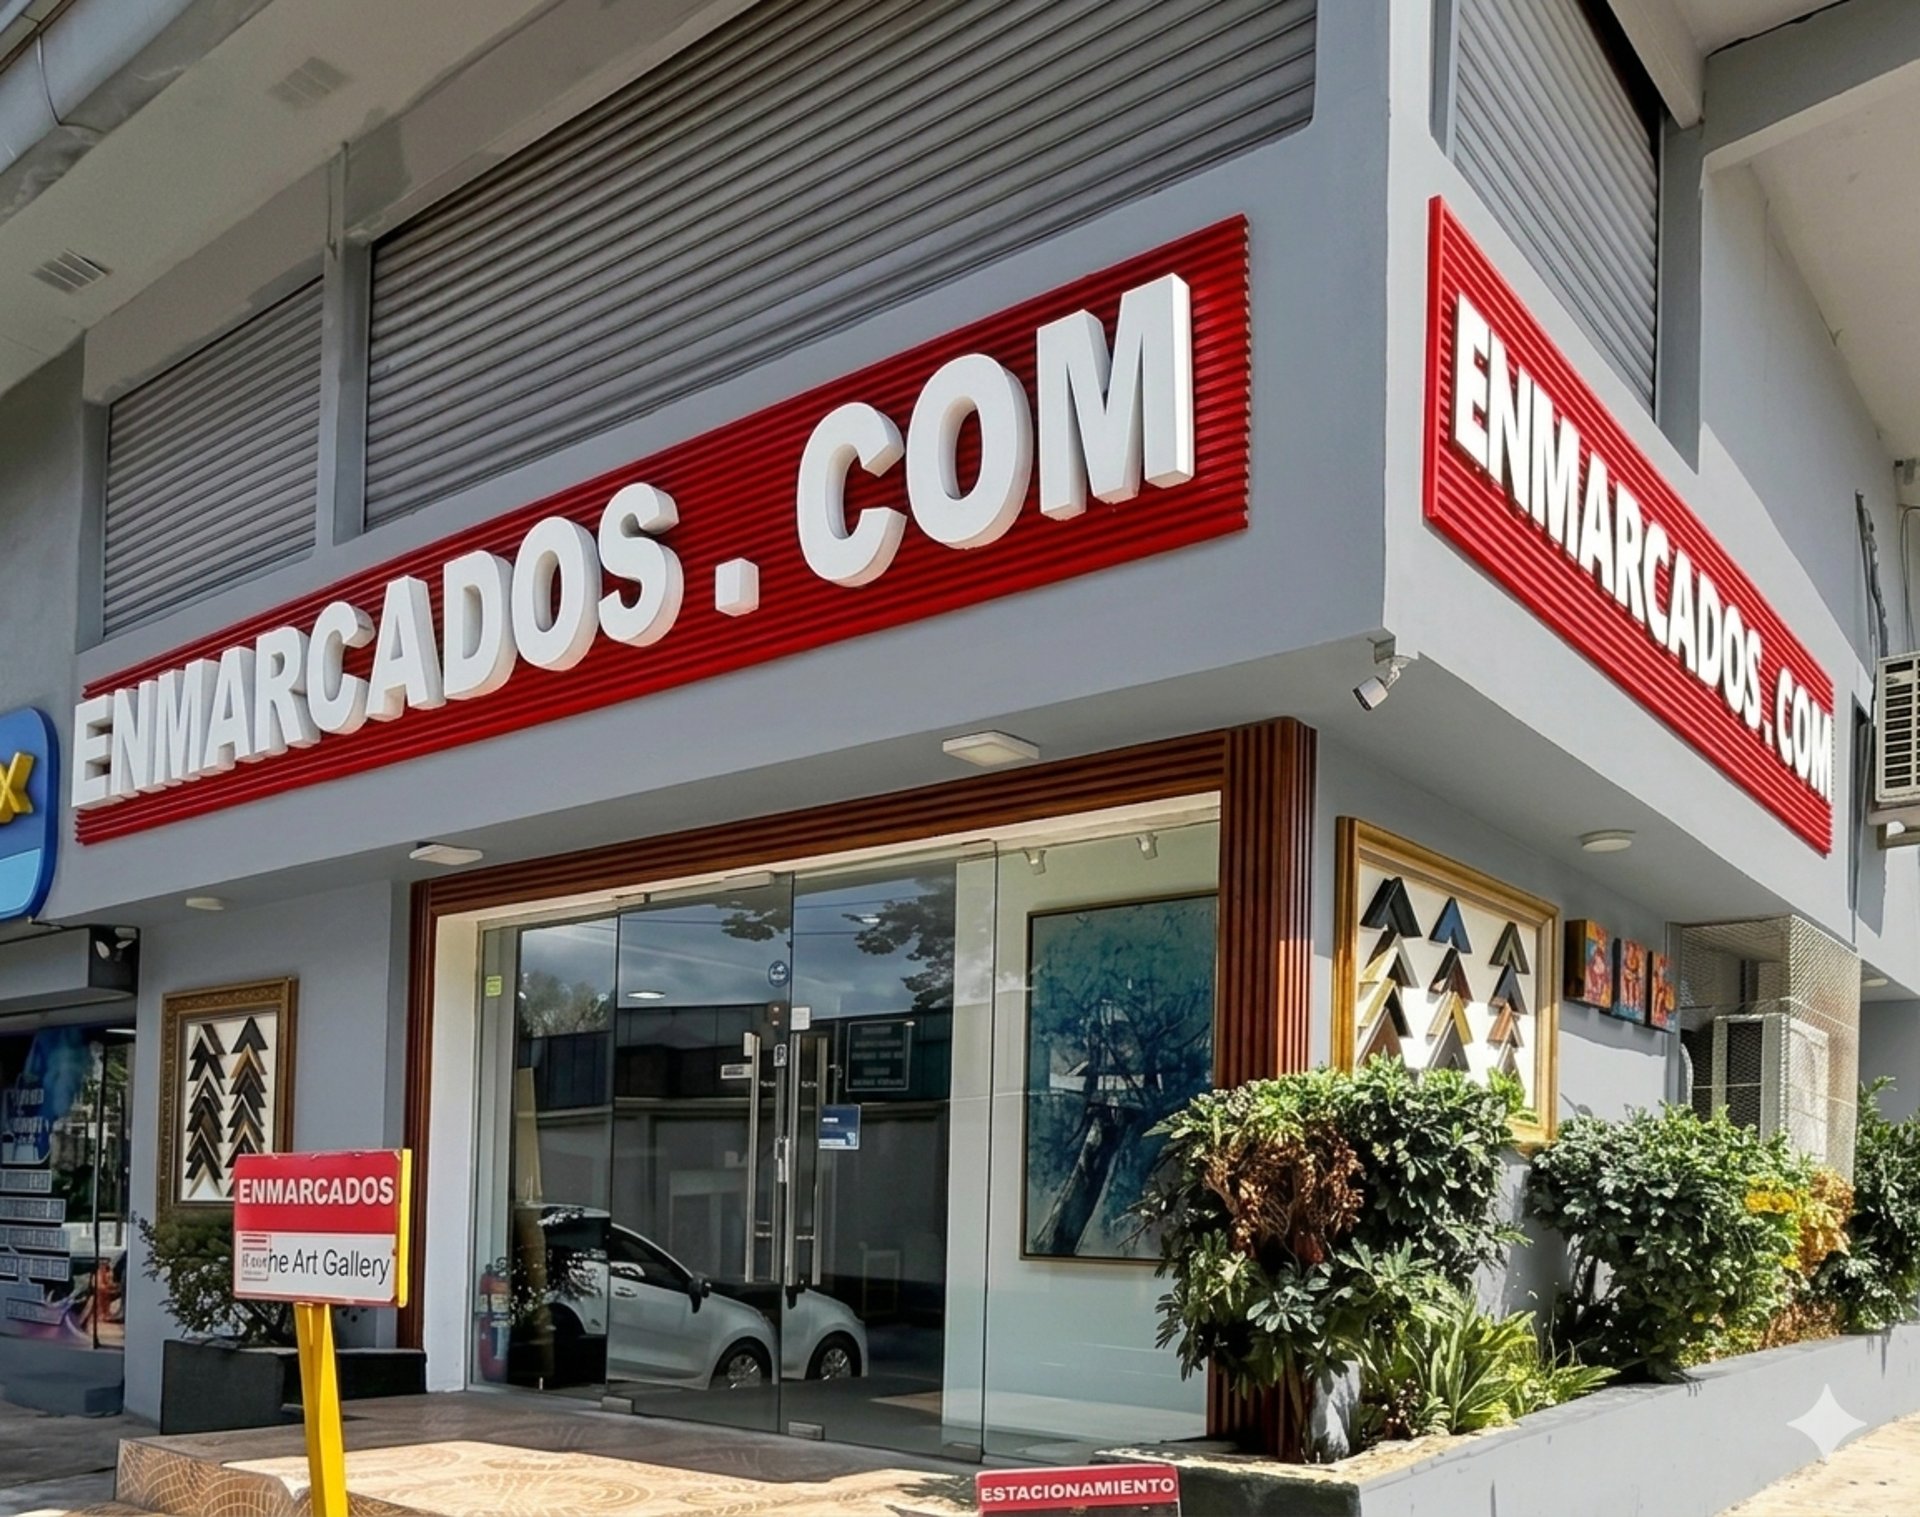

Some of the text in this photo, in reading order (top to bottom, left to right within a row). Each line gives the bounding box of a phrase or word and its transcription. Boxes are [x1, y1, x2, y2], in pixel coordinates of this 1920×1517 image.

[238, 1175, 394, 1205] ENMARCADOS
[292, 1248, 318, 1275] Art
[323, 1249, 390, 1285] Gallery
[981, 1477, 1175, 1502] ESTACIONAMIENTO
